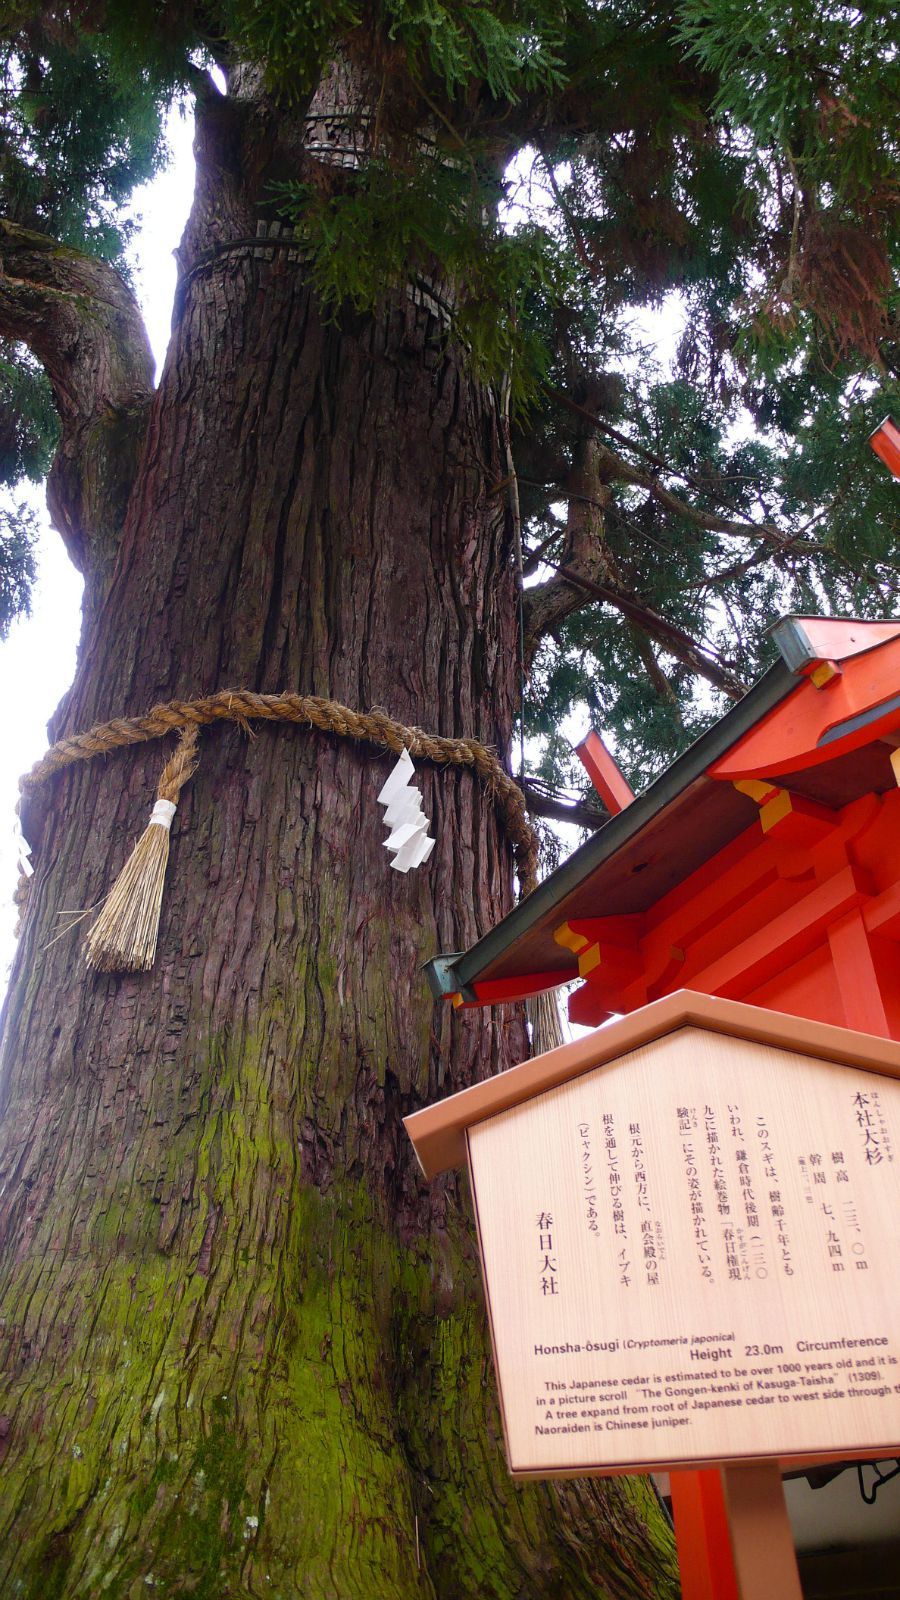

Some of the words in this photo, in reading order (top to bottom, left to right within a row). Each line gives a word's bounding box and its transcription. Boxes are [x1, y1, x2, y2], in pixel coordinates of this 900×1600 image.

[850, 1092, 883, 1165] 本社大杉
[810, 1154, 826, 1184] 幹周
[832, 1152, 849, 1182] 樹高
[536, 1212, 559, 1296] 春日大社
[690, 1348, 733, 1361] Height
[745, 1344, 784, 1357] 23.0m
[796, 1336, 888, 1352] Circumference
[536, 1396, 546, 1406] in
[550, 1397, 556, 1405] a
[559, 1393, 596, 1406] picture
[599, 1391, 628, 1401] scroll
[664, 1381, 740, 1398] Gongen-kenki
[744, 1380, 753, 1391] of
[848, 1370, 884, 1384] (1309).
[544, 1380, 566, 1391] This
[570, 1377, 618, 1390] Japanese
[622, 1375, 650, 1386] cedar
[653, 1374, 662, 1383] is
[665, 1370, 717, 1382] estimated
[721, 1370, 731, 1378] to
[734, 1367, 747, 1376] be
[750, 1367, 774, 1375] over
[777, 1363, 801, 1374] 1000
[804, 1362, 833, 1372] years
[836, 1358, 852, 1368] old
[856, 1356, 875, 1367] and
[878, 1356, 886, 1366] it
[888, 1354, 898, 1364] is
[545, 1410, 553, 1420] A
[556, 1410, 577, 1419] tree
[581, 1406, 620, 1418] expand
[623, 1405, 648, 1414] from
[652, 1402, 674, 1412] root
[677, 1401, 688, 1411] of
[691, 1398, 742, 1410] Japanese
[746, 1394, 774, 1406] cedar
[778, 1394, 789, 1403] to
[792, 1392, 820, 1402] west
[823, 1389, 844, 1399] side
[848, 1385, 891, 1398] through
[534, 1422, 591, 1435] Naoraiden
[594, 1422, 602, 1431] is
[606, 1419, 649, 1430] Chinese
[652, 1417, 692, 1429] juniper.
